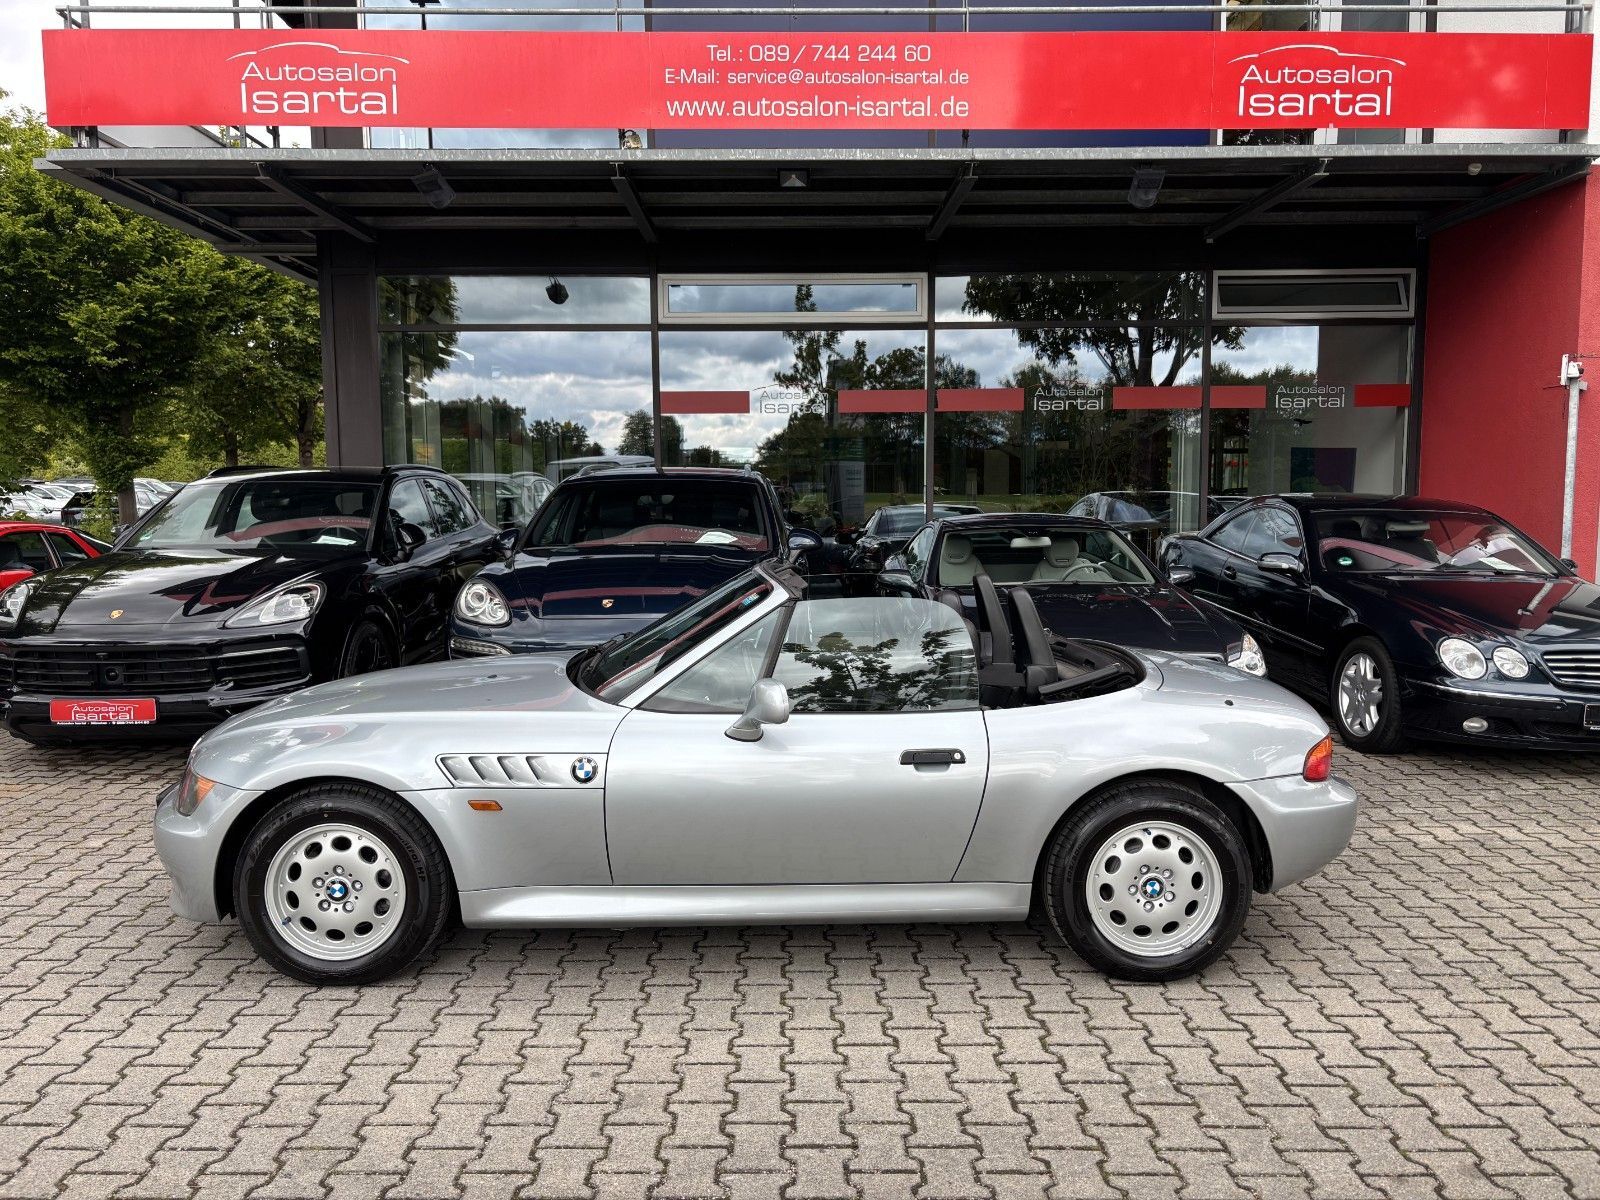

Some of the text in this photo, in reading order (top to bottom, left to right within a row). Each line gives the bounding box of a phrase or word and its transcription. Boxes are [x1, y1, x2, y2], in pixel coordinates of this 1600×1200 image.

[706, 44, 931, 64] Tel.: 089 / 744 244 60
[240, 61, 397, 82] Autosalon
[665, 68, 969, 85] E-Mail: service@autosalon-isartal.de
[1240, 64, 1393, 84] Autosalon
[240, 82, 398, 115] Isartal
[666, 95, 969, 118] www.autosalon-isartal.de
[1238, 85, 1392, 117] Isartal
[1034, 387, 1104, 396] Autosalon
[1276, 385, 1345, 394] Autosalon
[1033, 396, 1104, 411] Isartal
[1275, 394, 1345, 408] Isartal
[71, 707, 134, 720] Isartal
